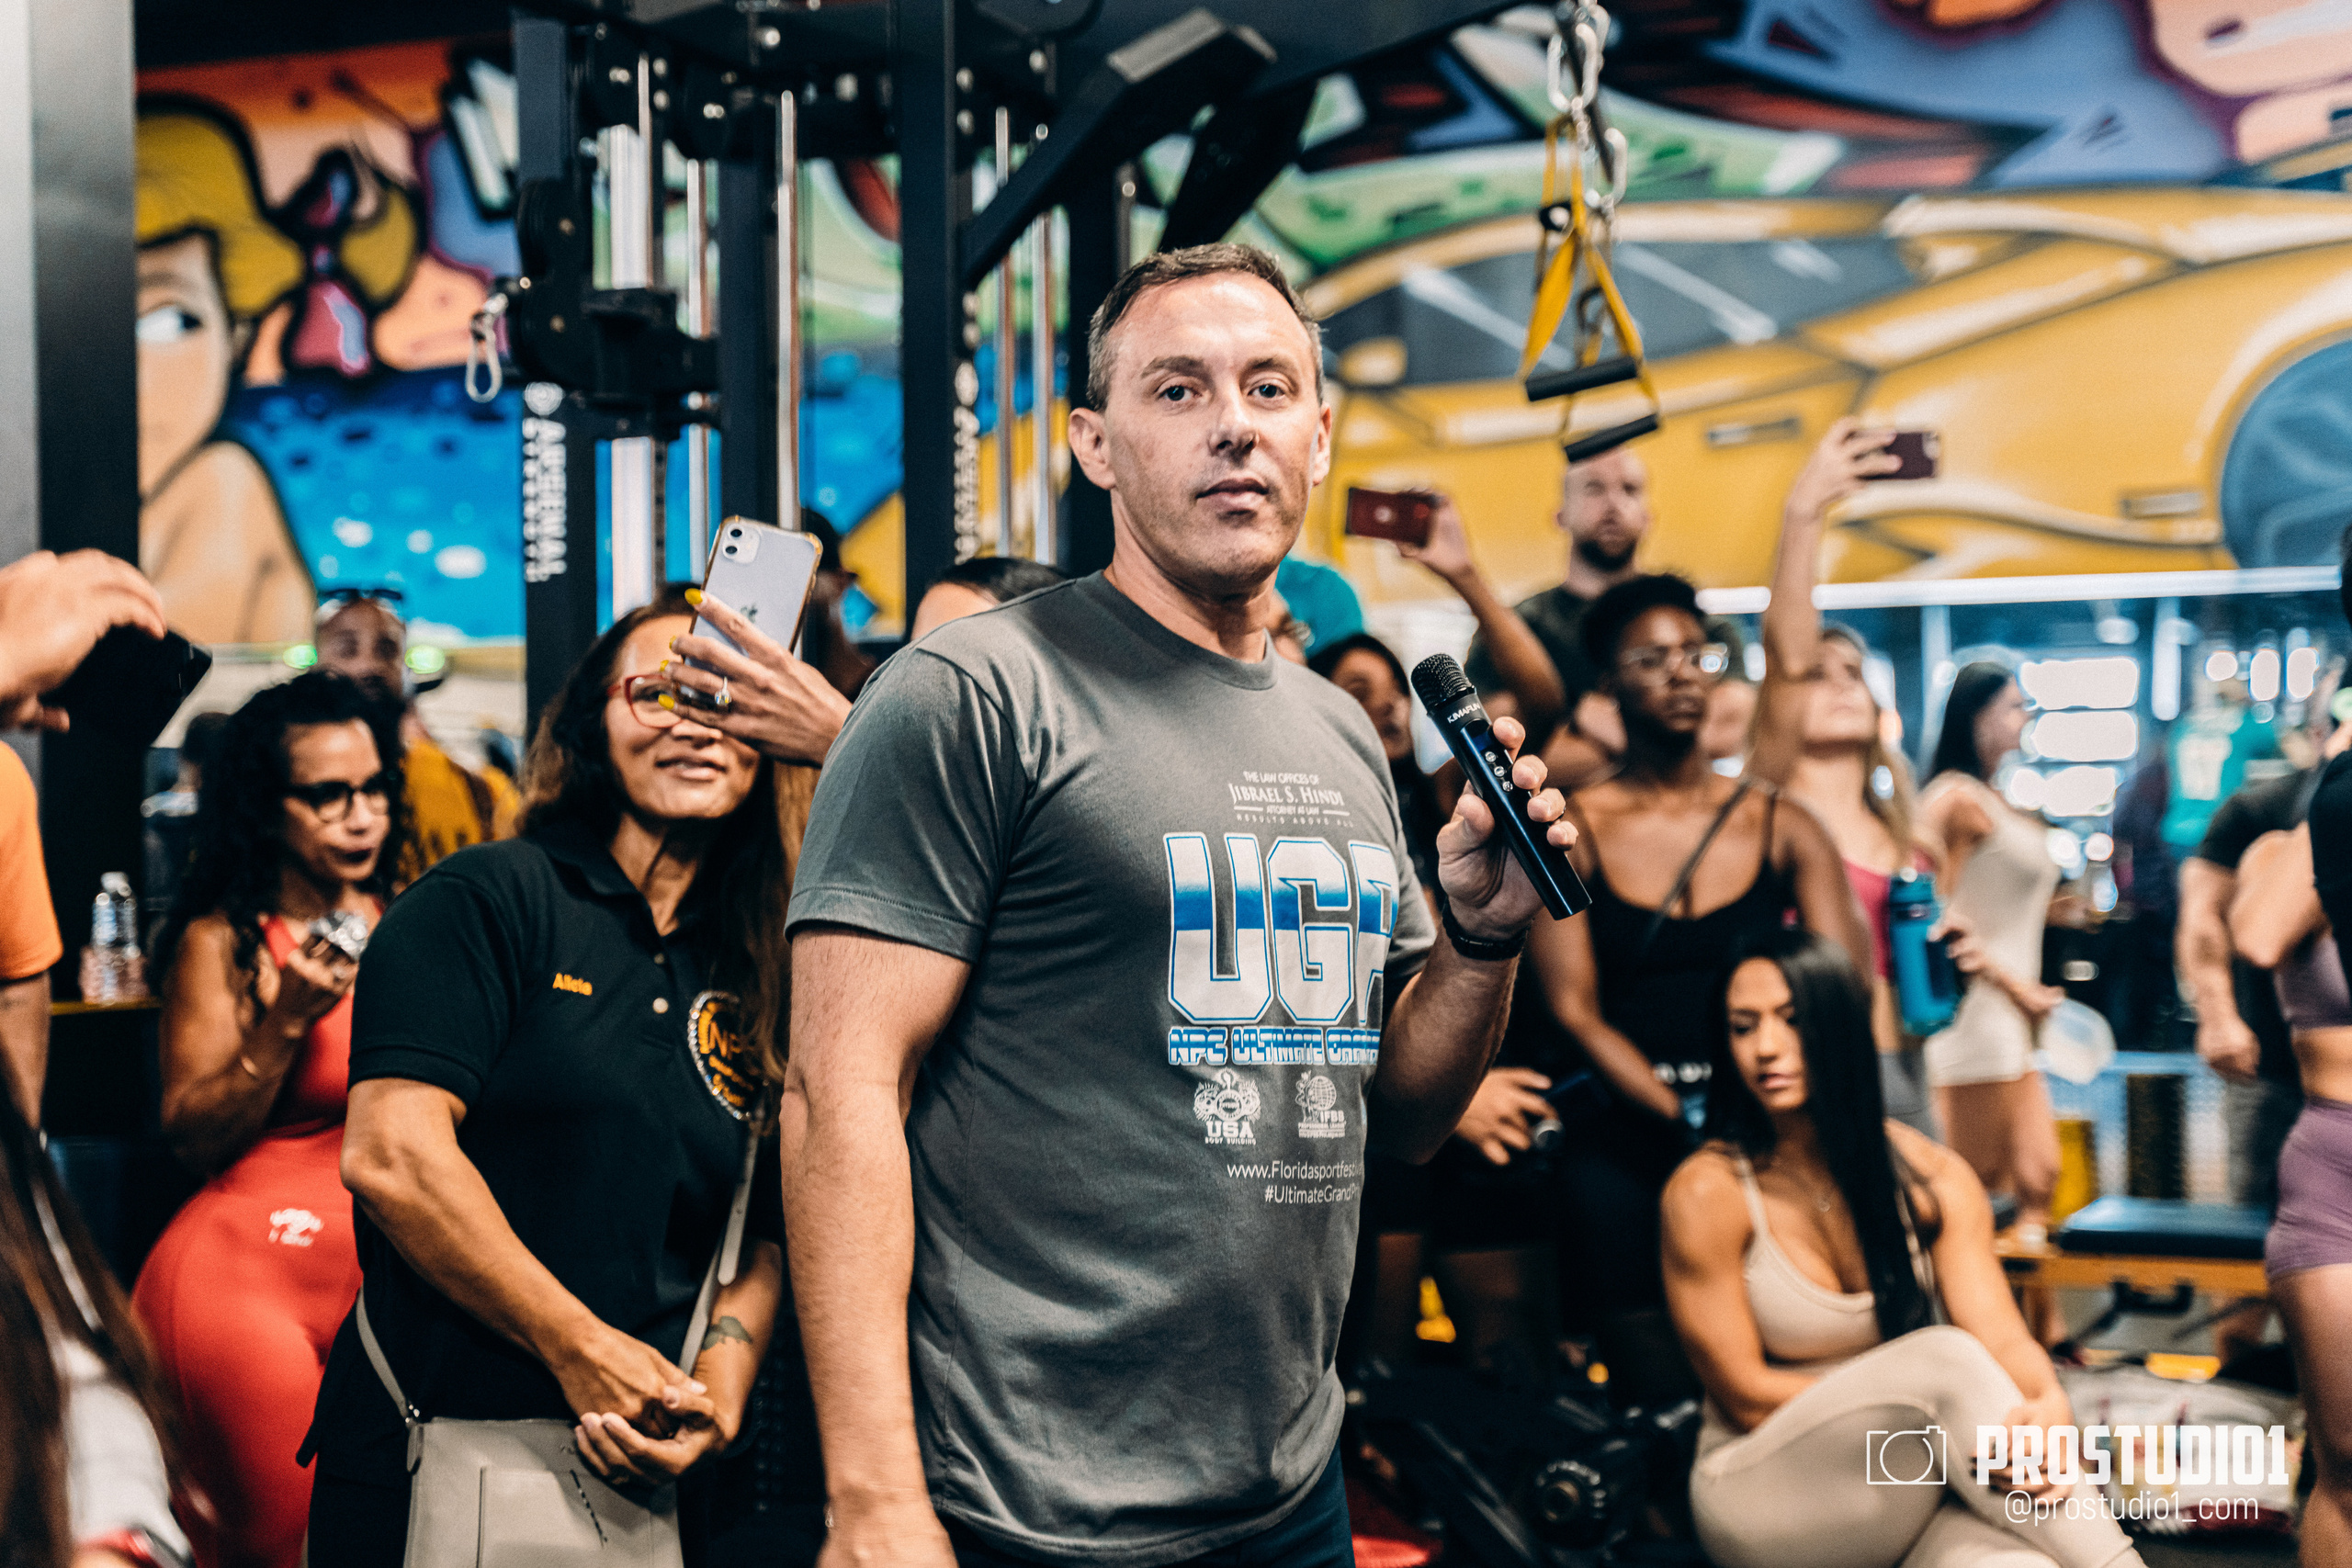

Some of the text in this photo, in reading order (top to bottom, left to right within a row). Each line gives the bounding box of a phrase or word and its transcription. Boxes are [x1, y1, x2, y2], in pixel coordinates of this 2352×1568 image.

[1447, 703, 1481, 724] KIMAFUN
[1243, 771, 1320, 785] THE LAW OFFICES OF
[1228, 783, 1345, 807] JIBRAEL S. HINDI
[1266, 805, 1296, 815] ATTORNEY
[1306, 806, 1319, 816] LAW
[1237, 813, 1285, 825] RESULTS
[552, 972, 594, 997] Alicia
[1169, 1026, 1228, 1066] NPC
[1232, 1026, 1325, 1066] ULTIMATE
[1319, 1110, 1345, 1122] IFBB
[1206, 1121, 1254, 1137] USA
[1205, 1136, 1257, 1145] BODY BUILDING
